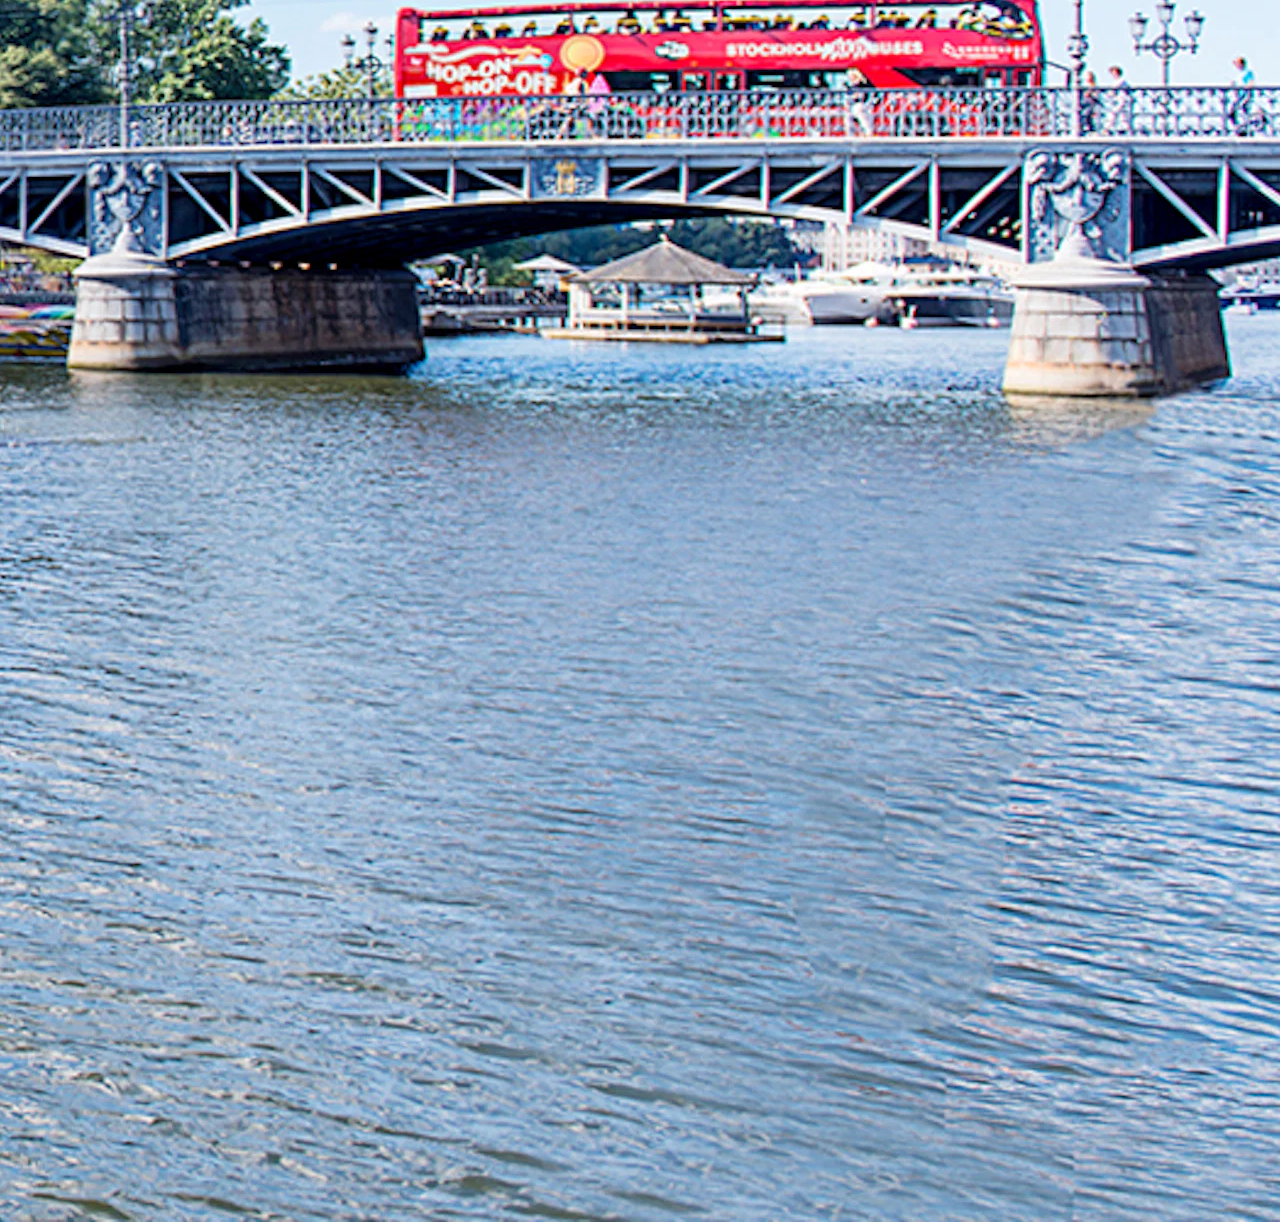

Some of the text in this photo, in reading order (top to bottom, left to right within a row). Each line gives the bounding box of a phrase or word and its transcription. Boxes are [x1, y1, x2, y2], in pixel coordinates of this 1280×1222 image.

[726, 42, 827, 57] STOCKHOLM
[870, 41, 924, 55] BUSES
[425, 56, 512, 83] HOP-ON
[462, 71, 558, 95] HOP-OFF
